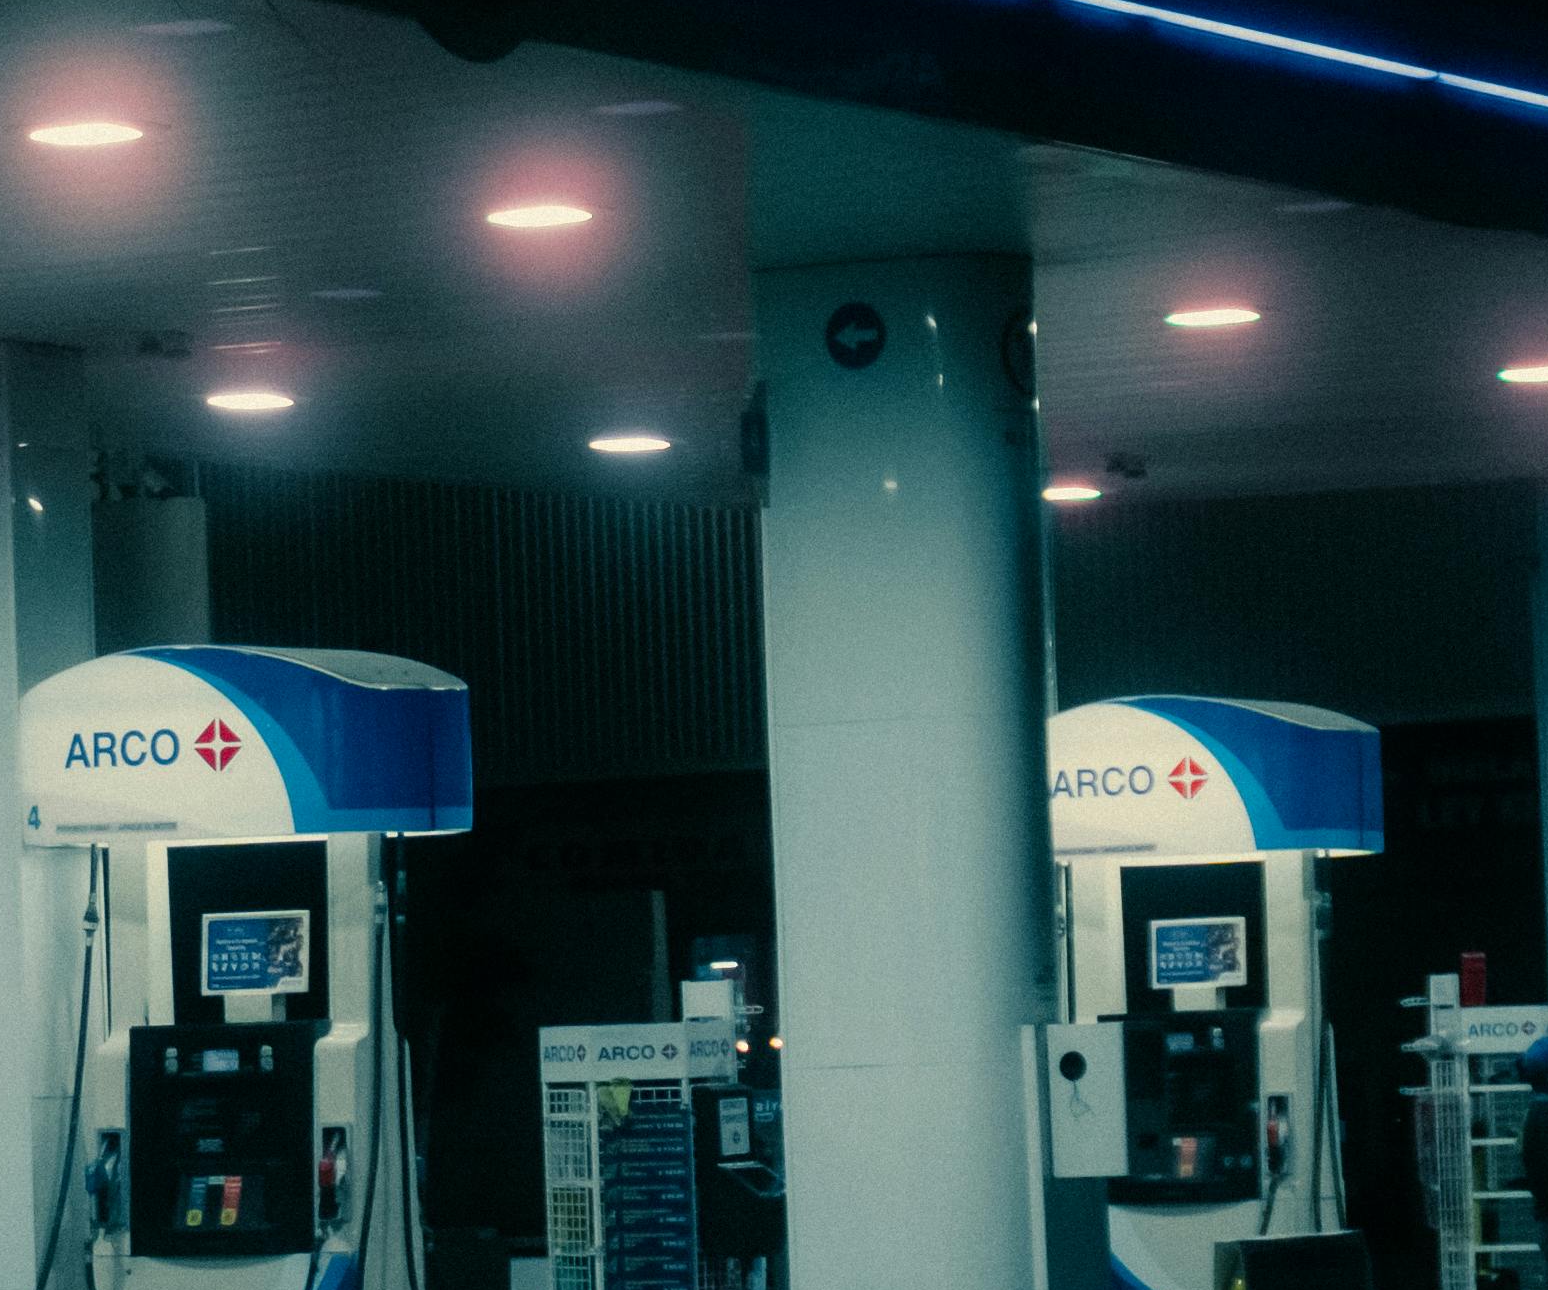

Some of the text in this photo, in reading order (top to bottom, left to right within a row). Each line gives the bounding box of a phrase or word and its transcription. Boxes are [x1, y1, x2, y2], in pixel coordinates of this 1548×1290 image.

[65, 728, 181, 769] ARCO
[1050, 764, 1155, 799] ARCO
[28, 806, 41, 829] 4
[1469, 1022, 1519, 1037] ARCO
[542, 1045, 575, 1062] ARCO
[598, 1044, 656, 1062] ARCO
[689, 1040, 720, 1057] ARCO
